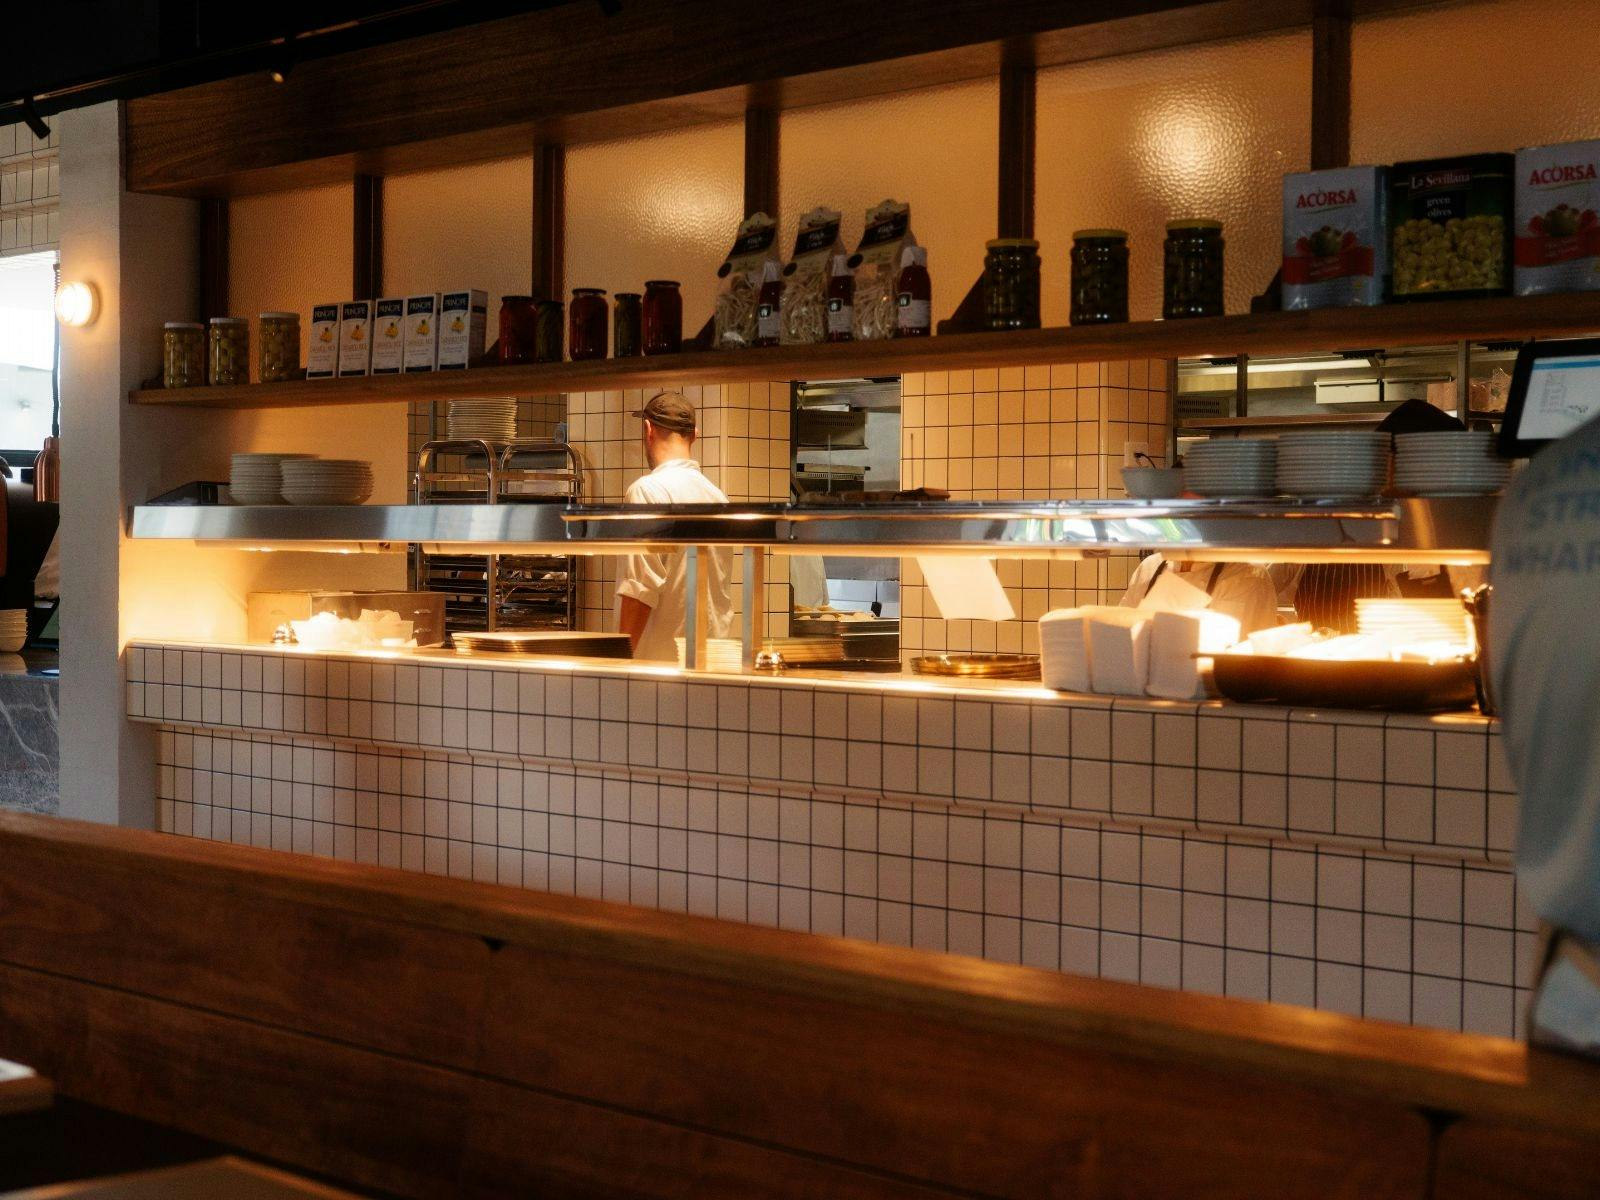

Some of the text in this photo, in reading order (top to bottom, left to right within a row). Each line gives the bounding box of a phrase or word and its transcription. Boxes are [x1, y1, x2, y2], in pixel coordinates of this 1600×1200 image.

[1411, 176, 1424, 189] La
[1529, 164, 1598, 185] ACORSA
[1297, 189, 1357, 208] ACORSA
